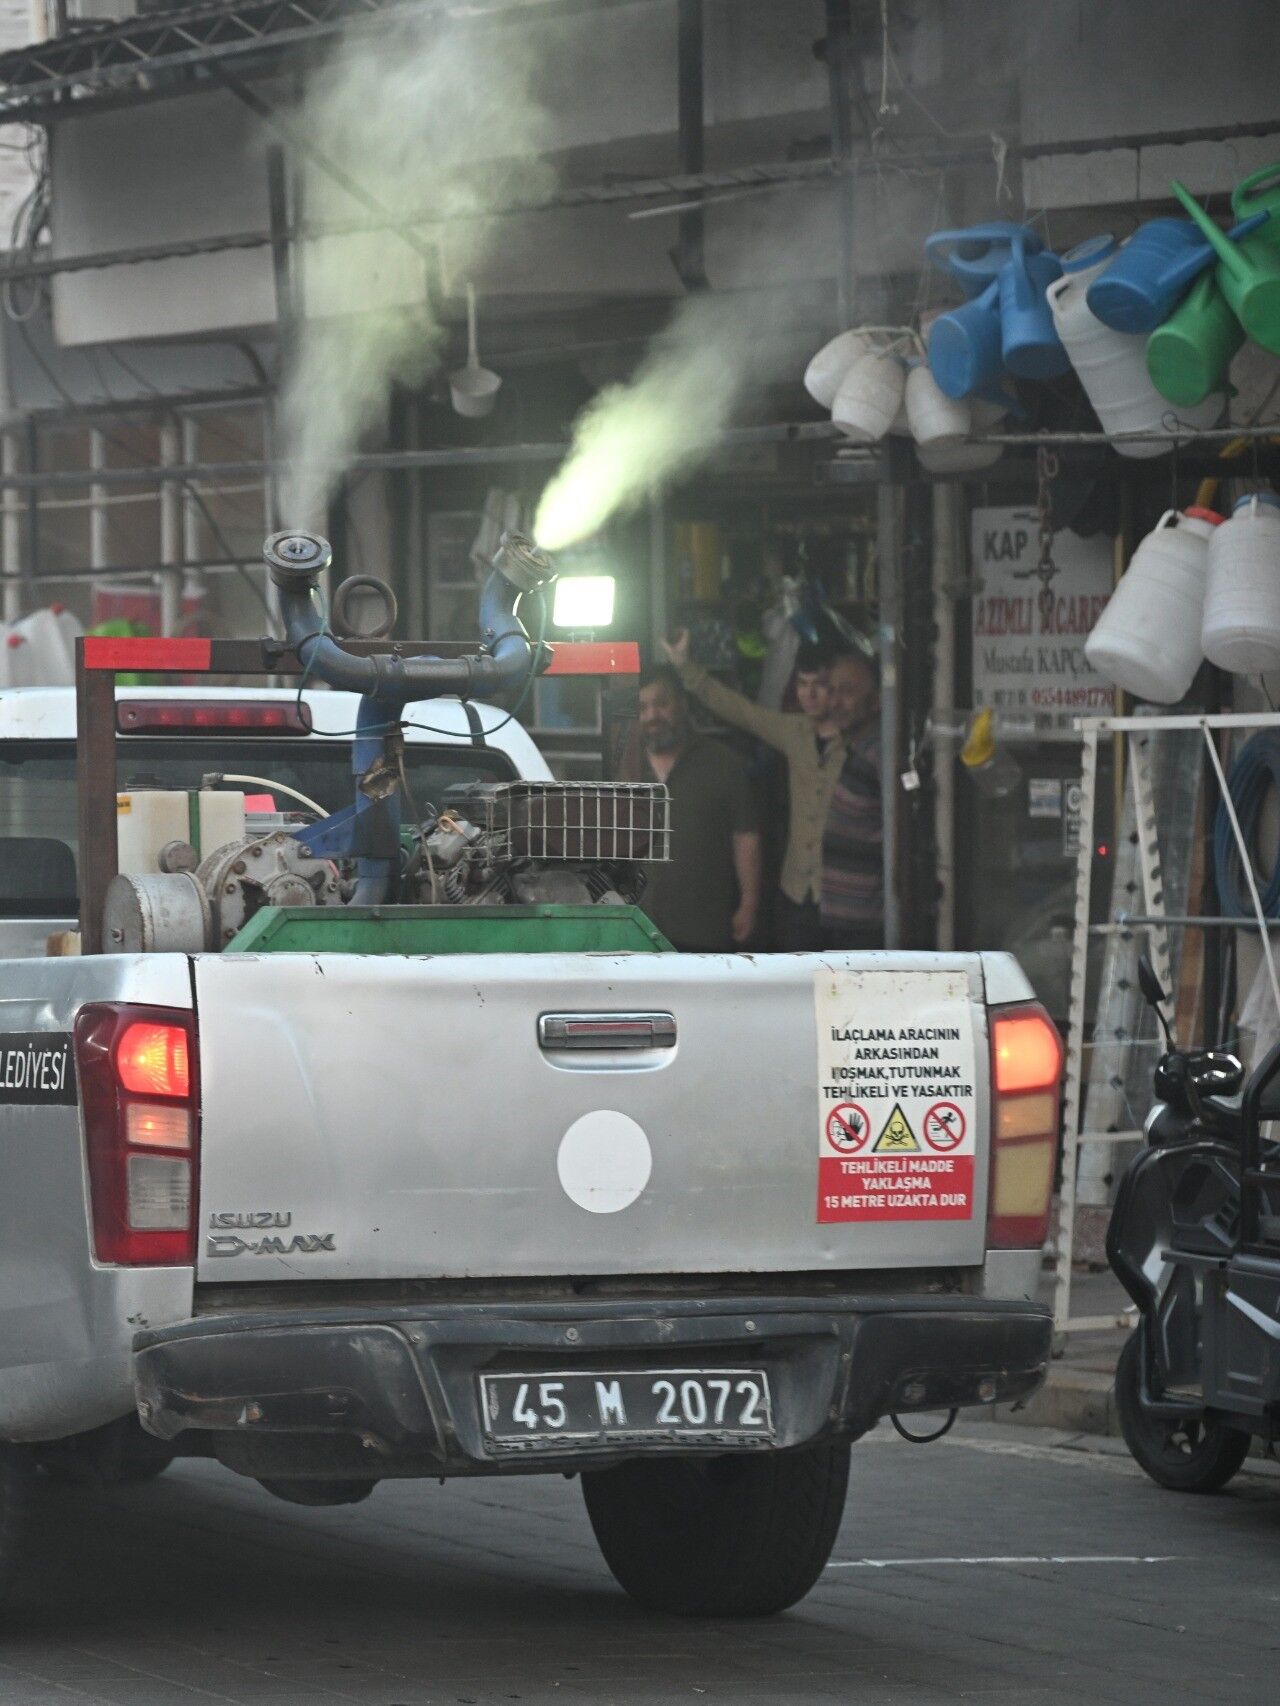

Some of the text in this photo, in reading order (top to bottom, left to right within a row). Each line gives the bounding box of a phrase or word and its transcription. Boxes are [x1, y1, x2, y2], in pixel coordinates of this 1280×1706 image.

[831, 1026, 960, 1044] İLAÇLAMA ARACININ
[855, 1047, 939, 1060] ARKASINDAN
[823, 1084, 973, 1098] TEHLİKELİ VE YASAKTIR
[840, 1157, 955, 1175] TEHLİKELİ MADDE
[862, 1177, 932, 1192] YAKLAŞMA
[824, 1193, 967, 1208] 15 METRE UZAKTA DUR
[209, 1211, 292, 1229] ISUZU
[512, 1379, 764, 1429] 45 M 2072
